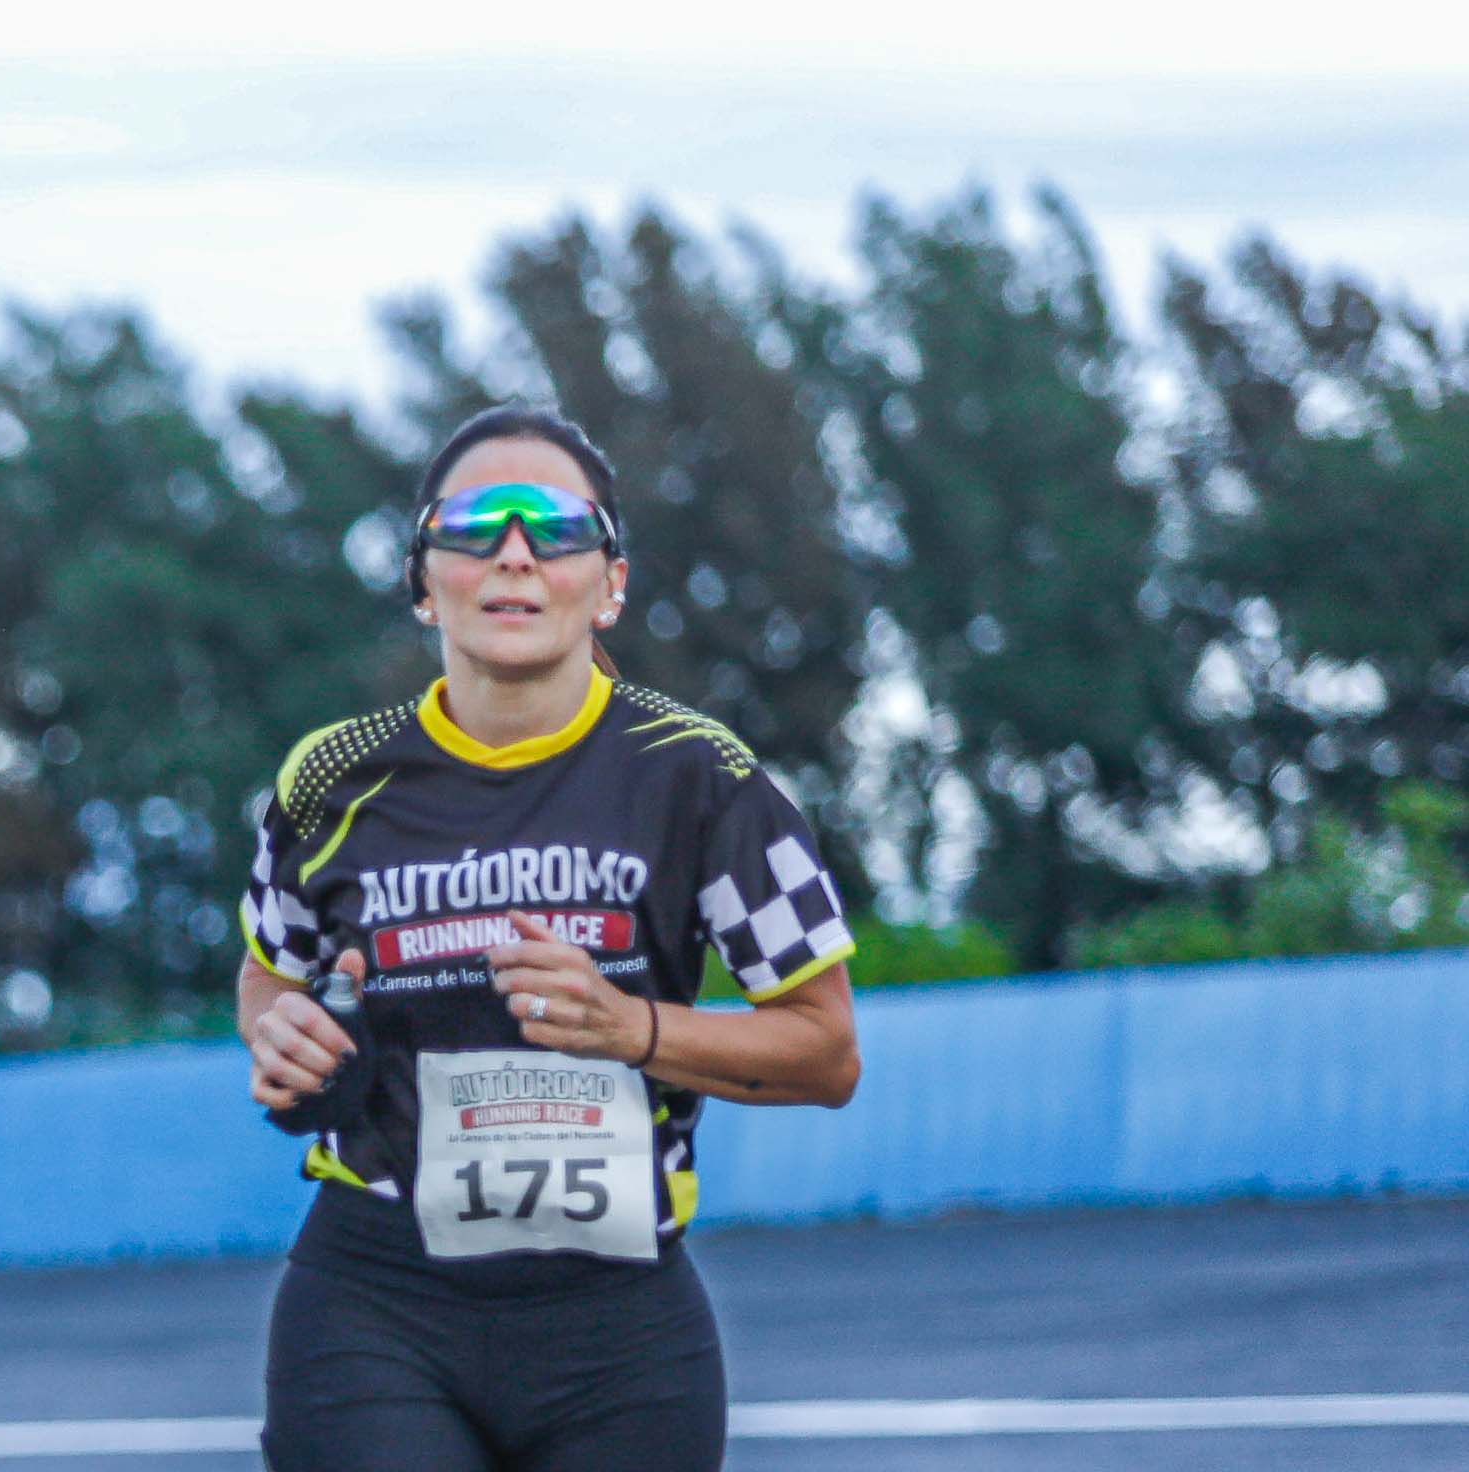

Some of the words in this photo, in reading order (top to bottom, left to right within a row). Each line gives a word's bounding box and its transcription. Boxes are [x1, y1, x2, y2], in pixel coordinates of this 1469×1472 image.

[359, 845, 648, 926] AUTÓDROMO
[378, 973, 432, 991] Carrera
[434, 969, 459, 986] de
[462, 968, 487, 984] los
[450, 1061, 615, 1106] AUTÓDROMO
[473, 1104, 542, 1127] RUNNING
[546, 1104, 587, 1124] RACE
[455, 1157, 610, 1222] 175
